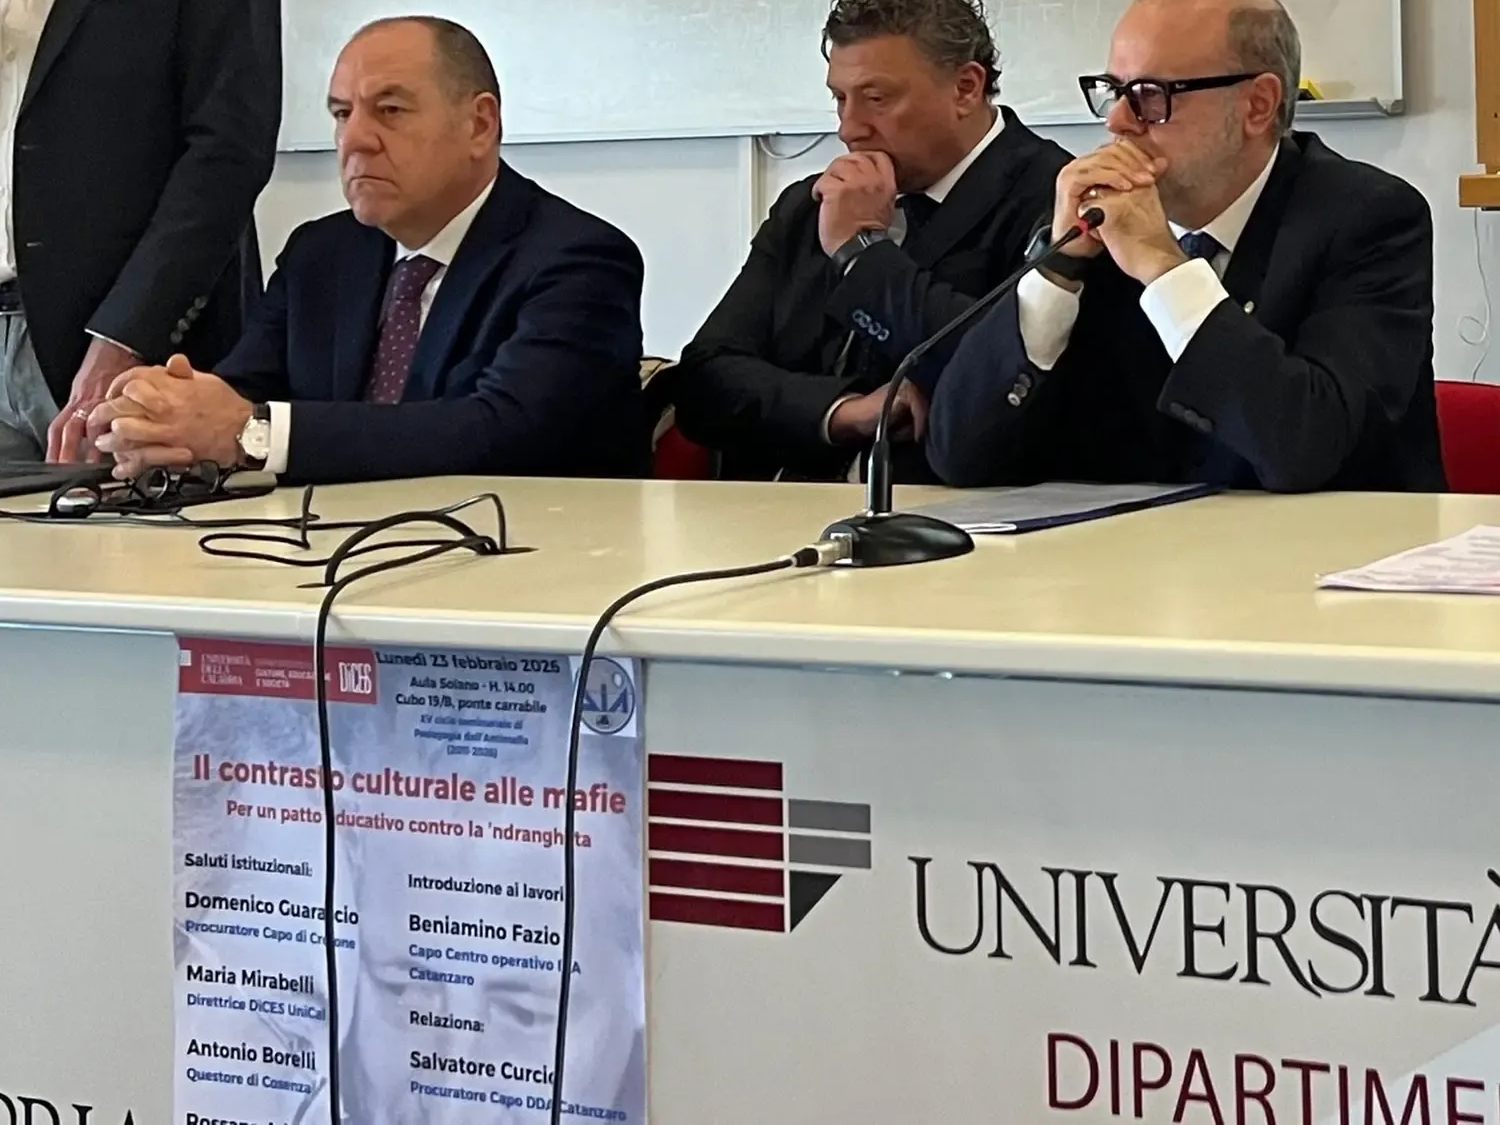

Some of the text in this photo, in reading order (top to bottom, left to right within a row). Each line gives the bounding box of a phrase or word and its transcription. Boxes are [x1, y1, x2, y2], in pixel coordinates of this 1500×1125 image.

[376, 651, 427, 667] Lunedì
[430, 654, 449, 668] 23
[453, 655, 518, 672] febbraio
[410, 676, 437, 690] Aula
[395, 693, 426, 707] Cubo
[193, 753, 210, 781] Il
[351, 767, 477, 802] culturale
[484, 776, 534, 807] alle
[226, 800, 592, 848] Per un patto ducativo contro la 'ndranghta
[184, 852, 228, 870] Saluti
[408, 874, 564, 902] Introduzione ai lavori
[185, 891, 360, 925] Domenico Guaracio
[185, 919, 260, 938] Procuratore
[262, 926, 293, 943] Capo
[295, 929, 307, 944] di
[408, 913, 561, 946] Beniamino Fazio
[408, 944, 443, 961] Capo
[445, 946, 489, 964] Centro
[491, 954, 555, 973] operativo
[186, 964, 315, 995] Maria Mirabelli
[408, 967, 475, 986] Catanzaro
[187, 993, 246, 1011] Direttrice
[409, 1009, 485, 1033] Relaziona:
[186, 1038, 316, 1071] Antonio Borelli
[409, 1050, 496, 1077] Salvatore
[186, 1066, 312, 1095] Questore di Cosenza
[410, 1080, 486, 1103] Procuratore
[490, 1090, 523, 1108] Capo
